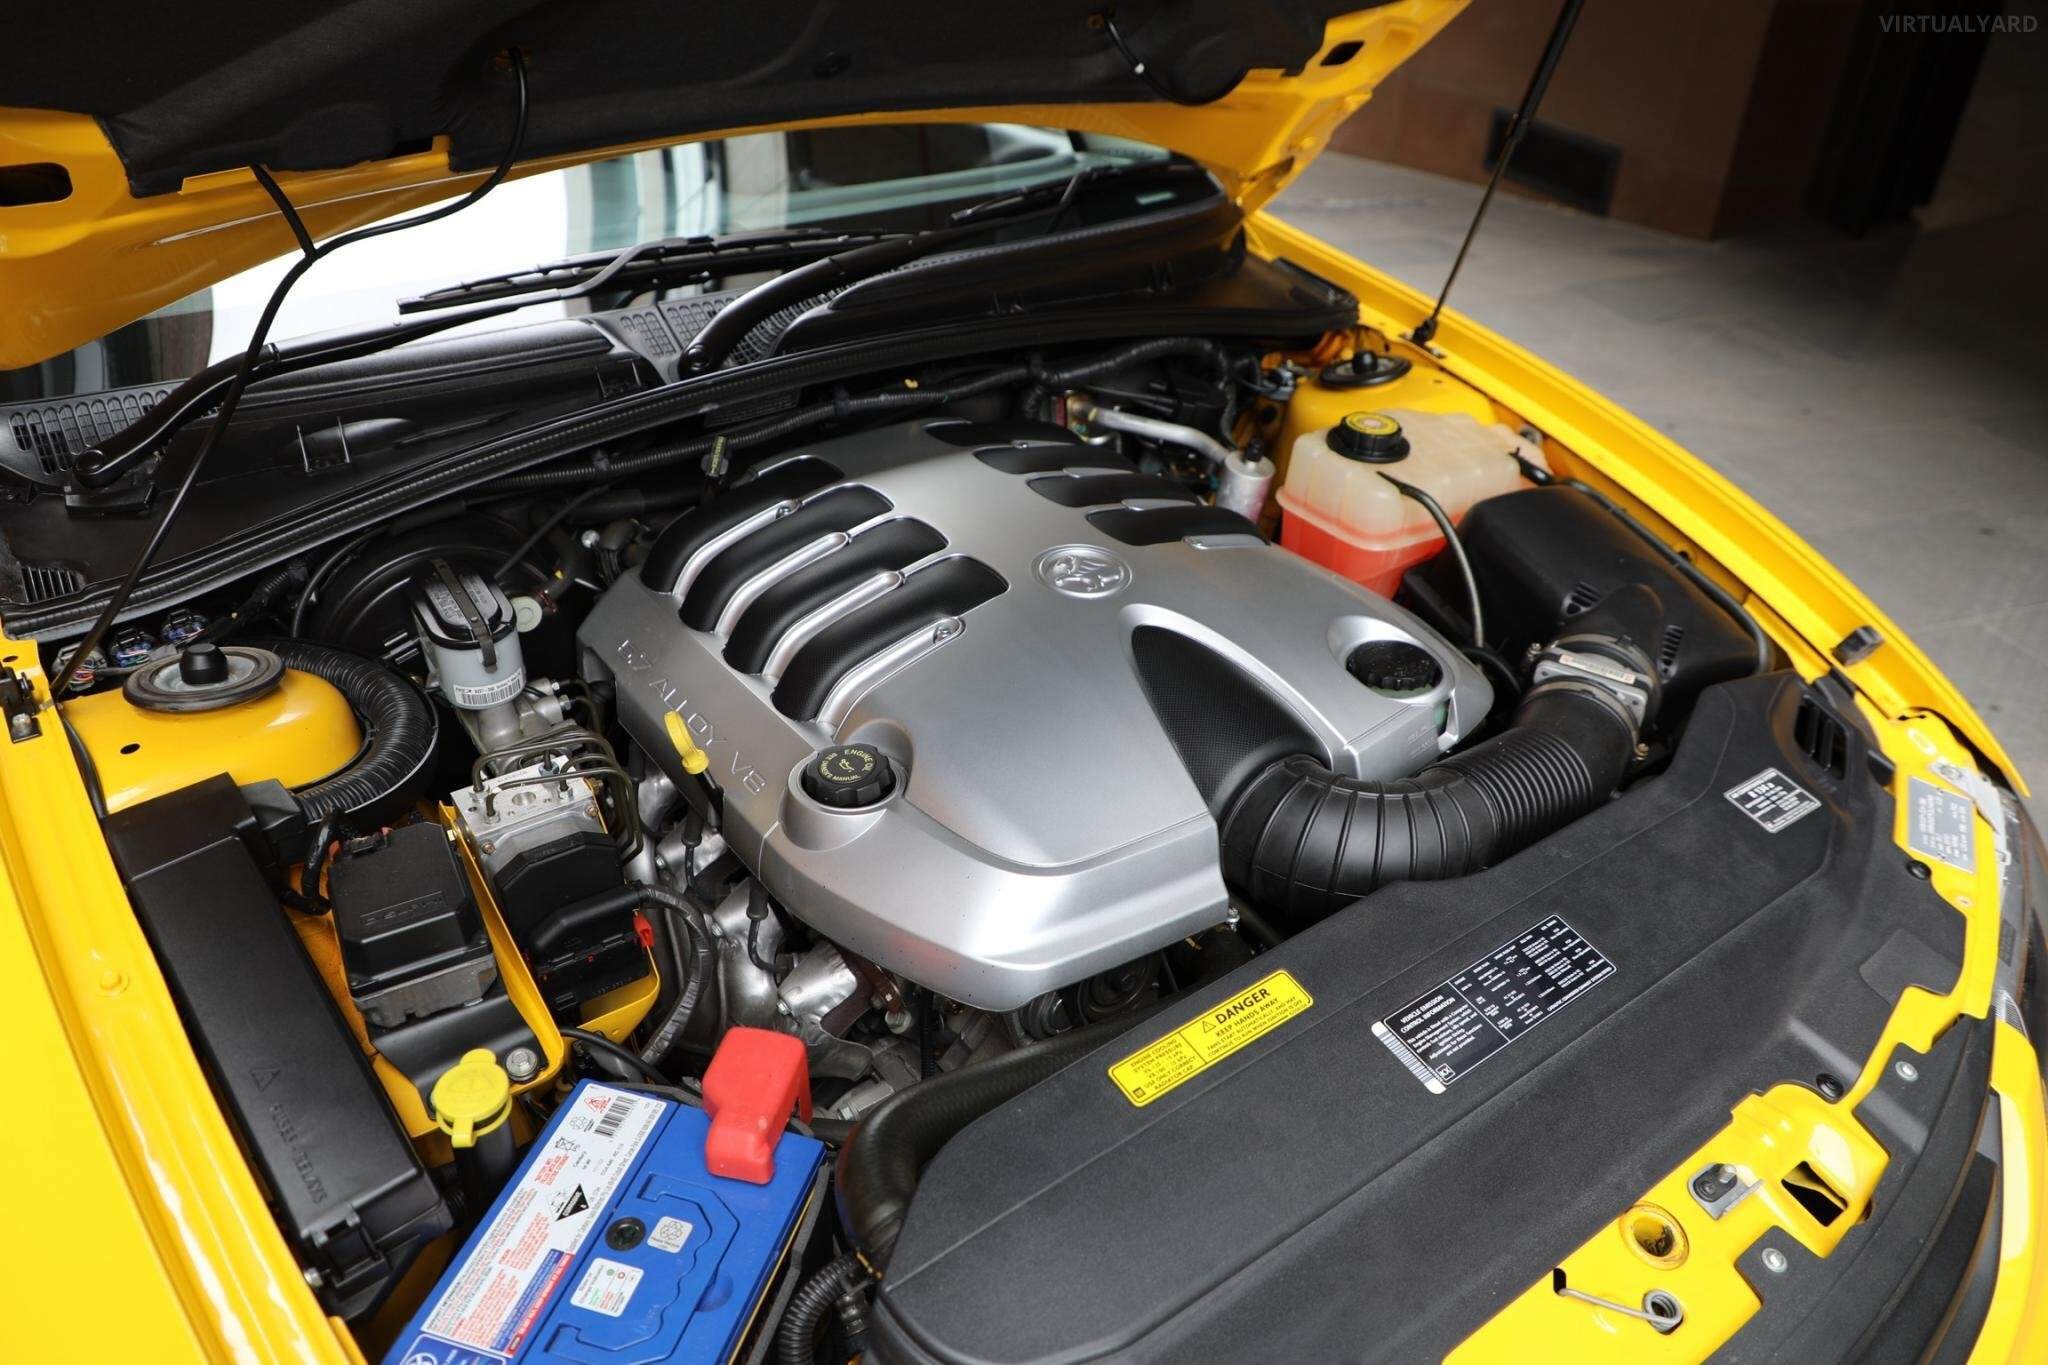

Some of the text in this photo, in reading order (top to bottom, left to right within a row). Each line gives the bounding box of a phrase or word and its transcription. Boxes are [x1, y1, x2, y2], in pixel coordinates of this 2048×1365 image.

[649, 678, 728, 747] ALLOY
[731, 751, 767, 796] V8
[844, 749, 873, 763] ENGINE
[1213, 986, 1271, 1025] DANGER
[1214, 1023, 1234, 1037] KEEP
[1232, 1008, 1260, 1027] HANDS
[1258, 996, 1280, 1012] AWAY
[1398, 1015, 1425, 1034] CONTROL
[1421, 995, 1456, 1020] INFORMATION
[1399, 993, 1444, 1024] VEHICLE EMISSION
[1129, 1052, 1152, 1067] ENGINE
[1150, 1037, 1177, 1056] COOLING
[1206, 1039, 1233, 1058] CONTINUE
[1240, 1028, 1253, 1038] RUN
[1251, 1019, 1267, 1031] WHEN
[1219, 1030, 1236, 1043] START
[1132, 1057, 1155, 1073] SYSTEM
[1154, 1041, 1183, 1061] PRESSURE
[1142, 1078, 1156, 1089] USE
[1154, 1069, 1172, 1082] ONLY
[1170, 1054, 1197, 1073] CORRECT
[1153, 1070, 1182, 1091] RADIATOR
[1181, 1063, 1194, 1074] CAP
